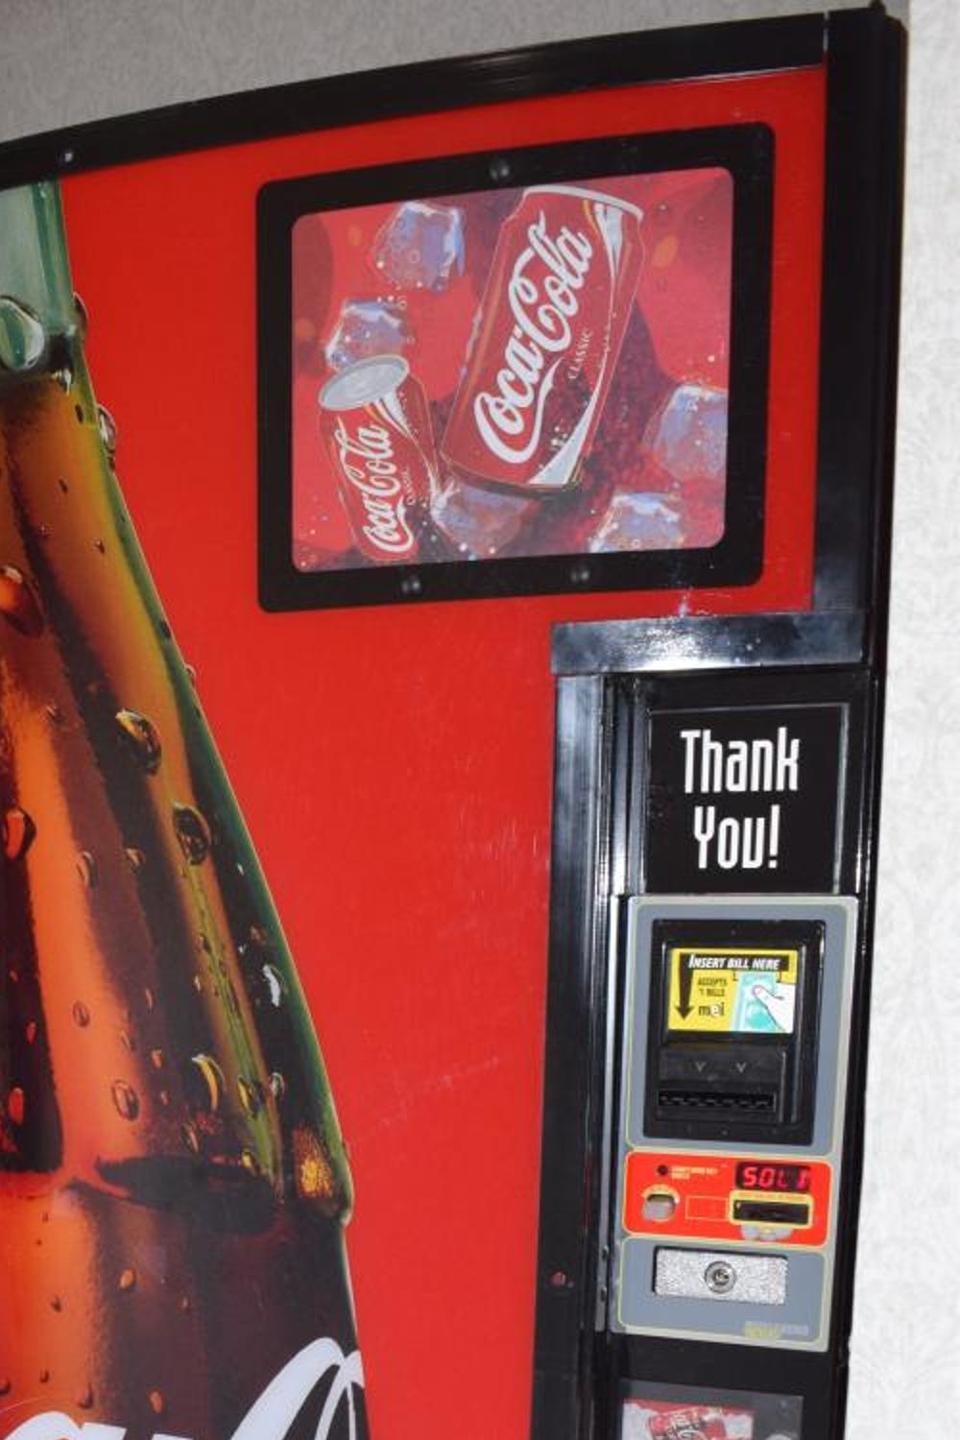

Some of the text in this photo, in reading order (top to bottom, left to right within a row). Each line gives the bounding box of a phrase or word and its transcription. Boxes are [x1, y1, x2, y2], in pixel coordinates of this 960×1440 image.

[473, 208, 593, 463] Coca-Cola
[335, 417, 413, 552] Coca-Cola
[680, 727, 800, 793] Thank
[694, 804, 781, 870] You!
